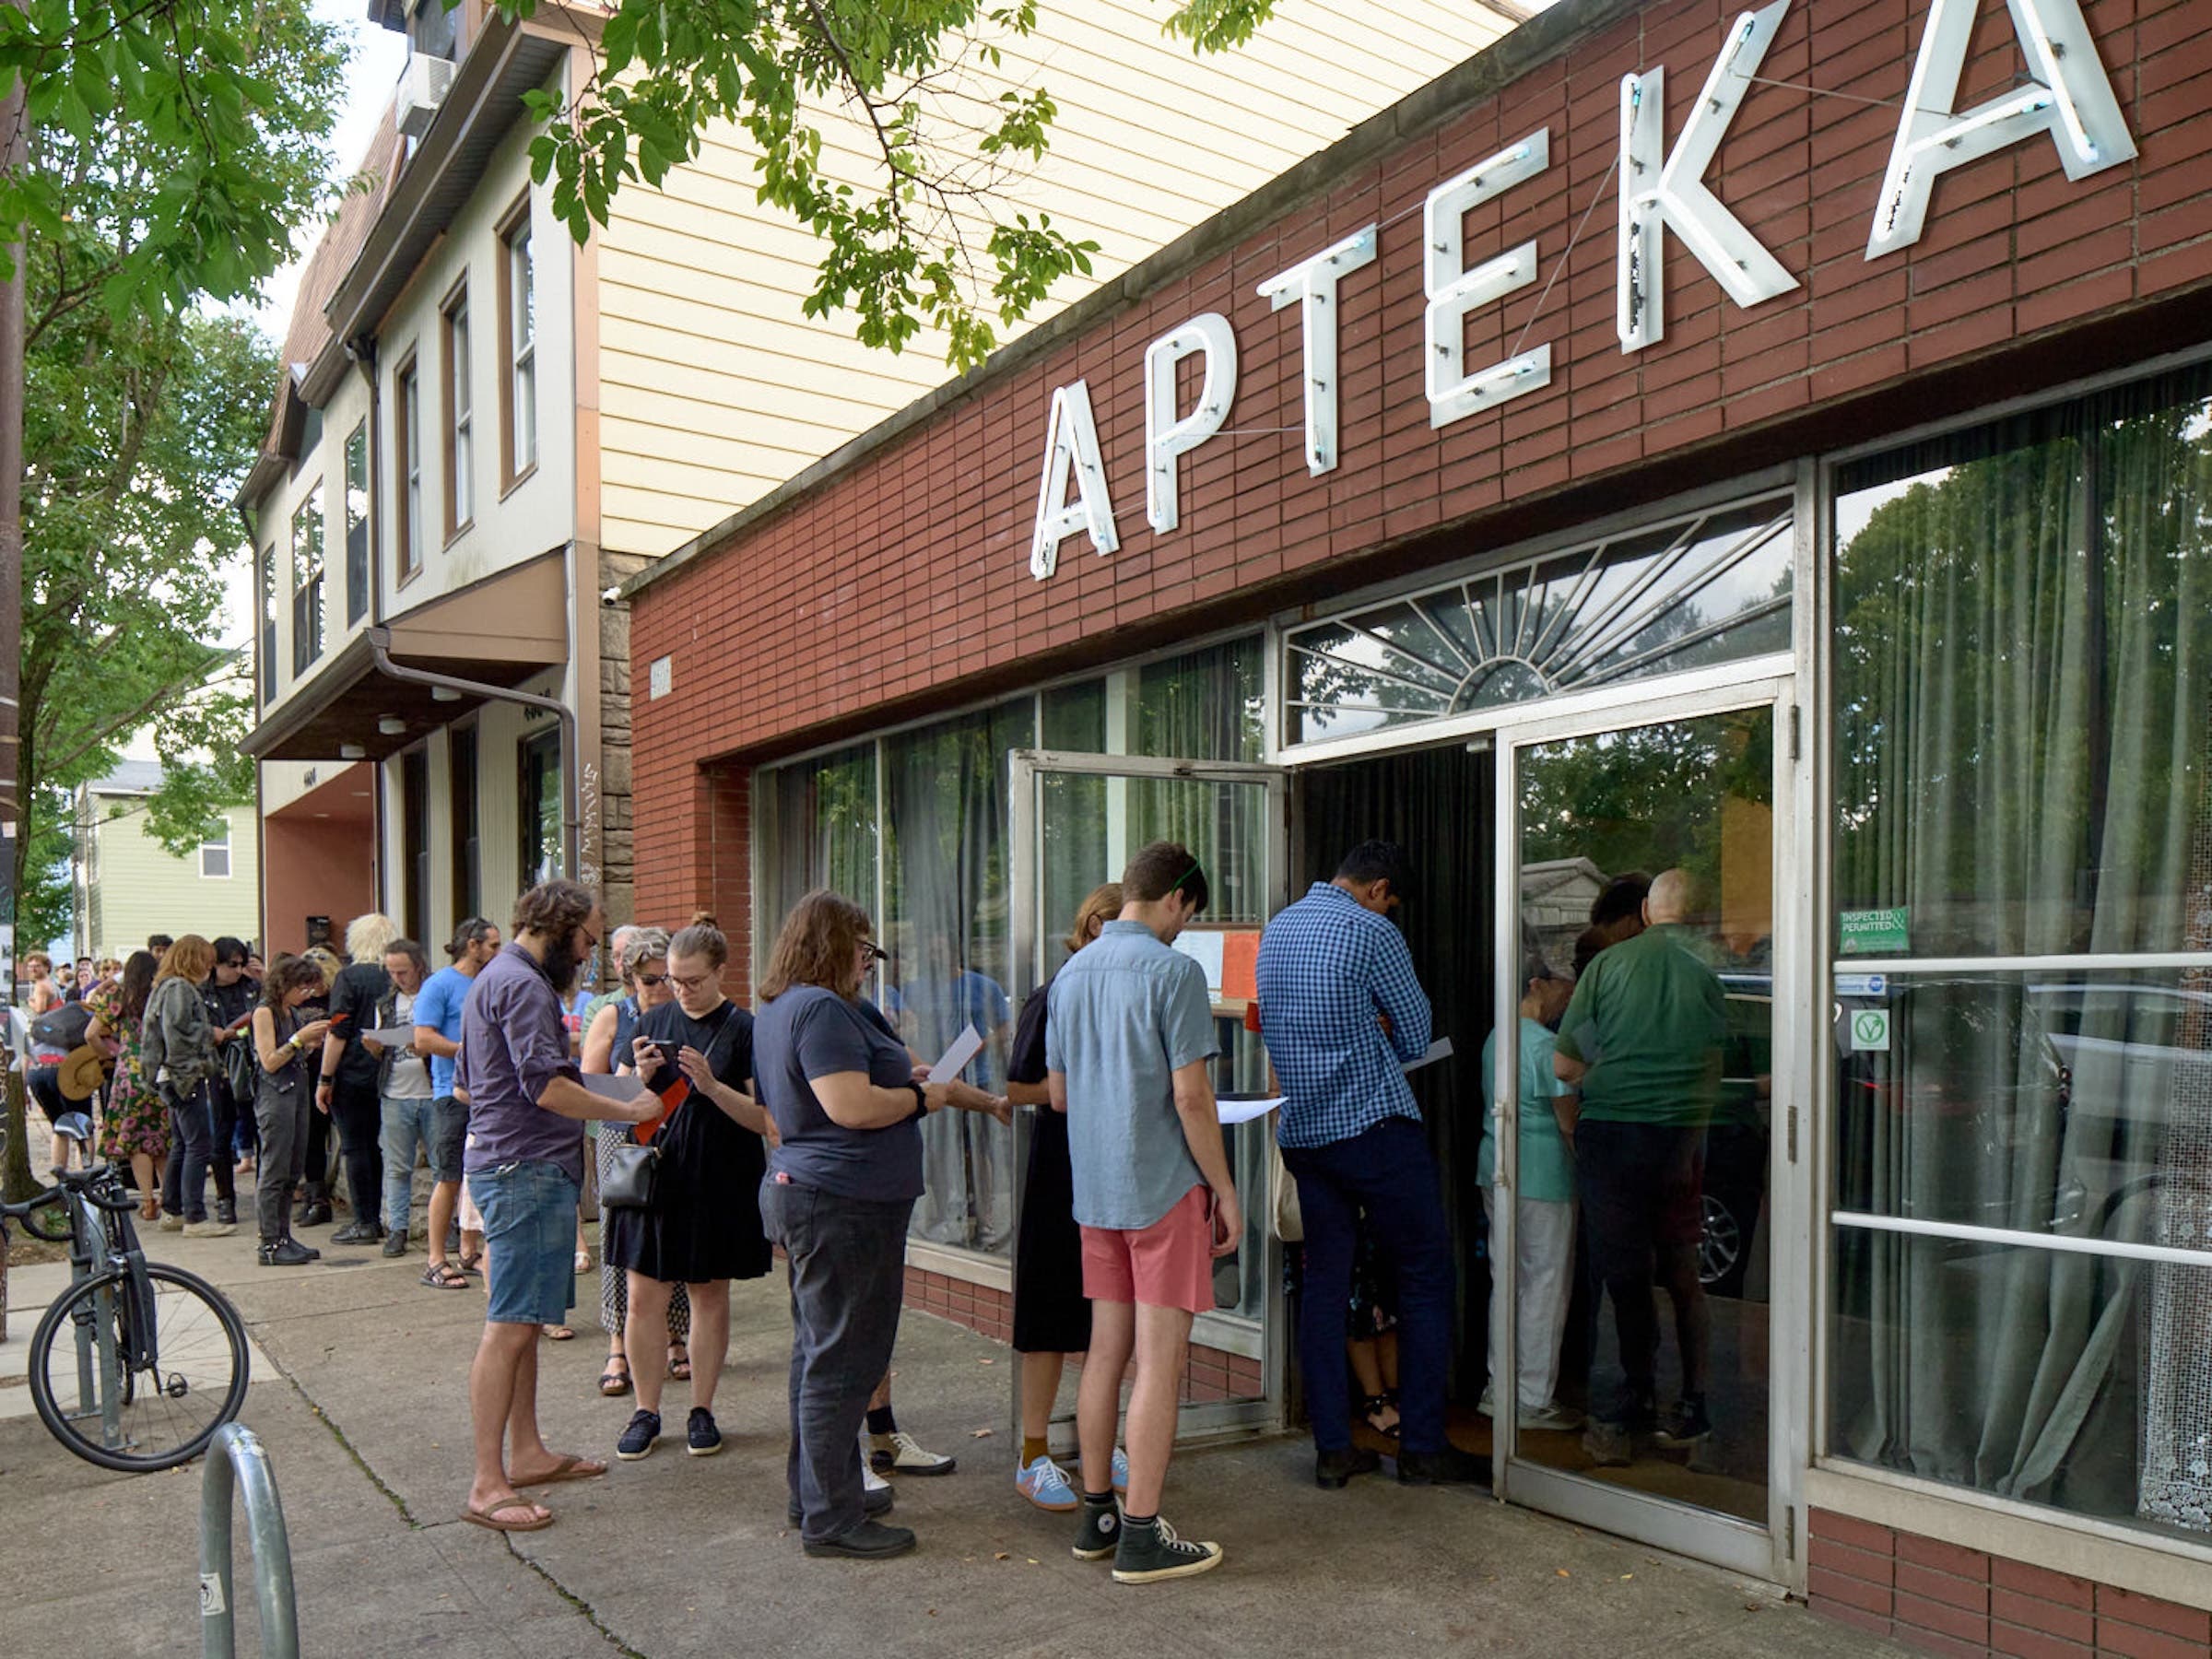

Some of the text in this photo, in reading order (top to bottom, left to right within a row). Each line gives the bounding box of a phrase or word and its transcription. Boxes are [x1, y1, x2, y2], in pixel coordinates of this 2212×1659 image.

[1030, 0, 2139, 582] APTEKA
[1842, 910, 1893, 922] INSPECTED
[1843, 921, 1892, 933] PERMITTED
